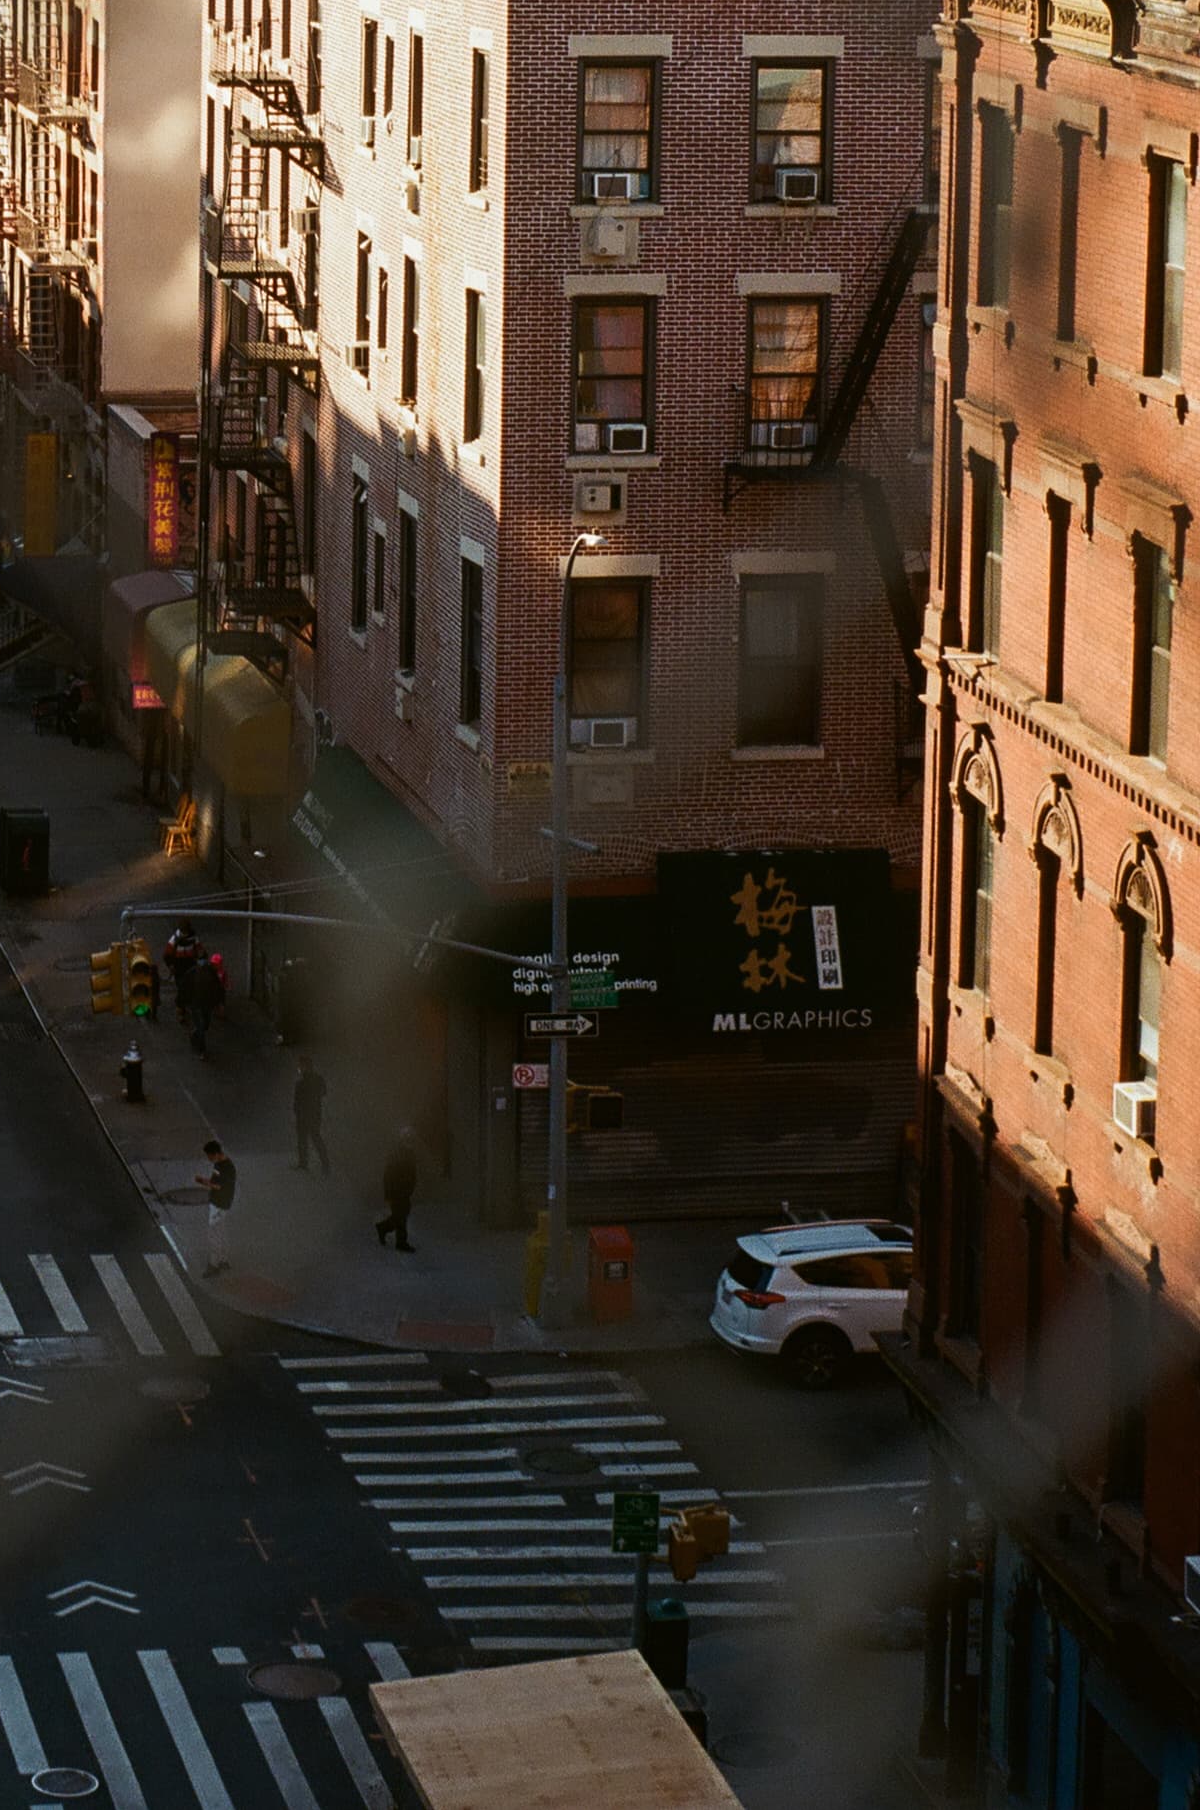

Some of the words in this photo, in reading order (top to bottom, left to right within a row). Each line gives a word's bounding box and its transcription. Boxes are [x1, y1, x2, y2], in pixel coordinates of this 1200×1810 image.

[573, 952, 620, 966] design
[513, 982, 539, 996] high
[614, 978, 658, 992] printing
[536, 1021, 555, 1031] ONE
[565, 1020, 586, 1030] WAY
